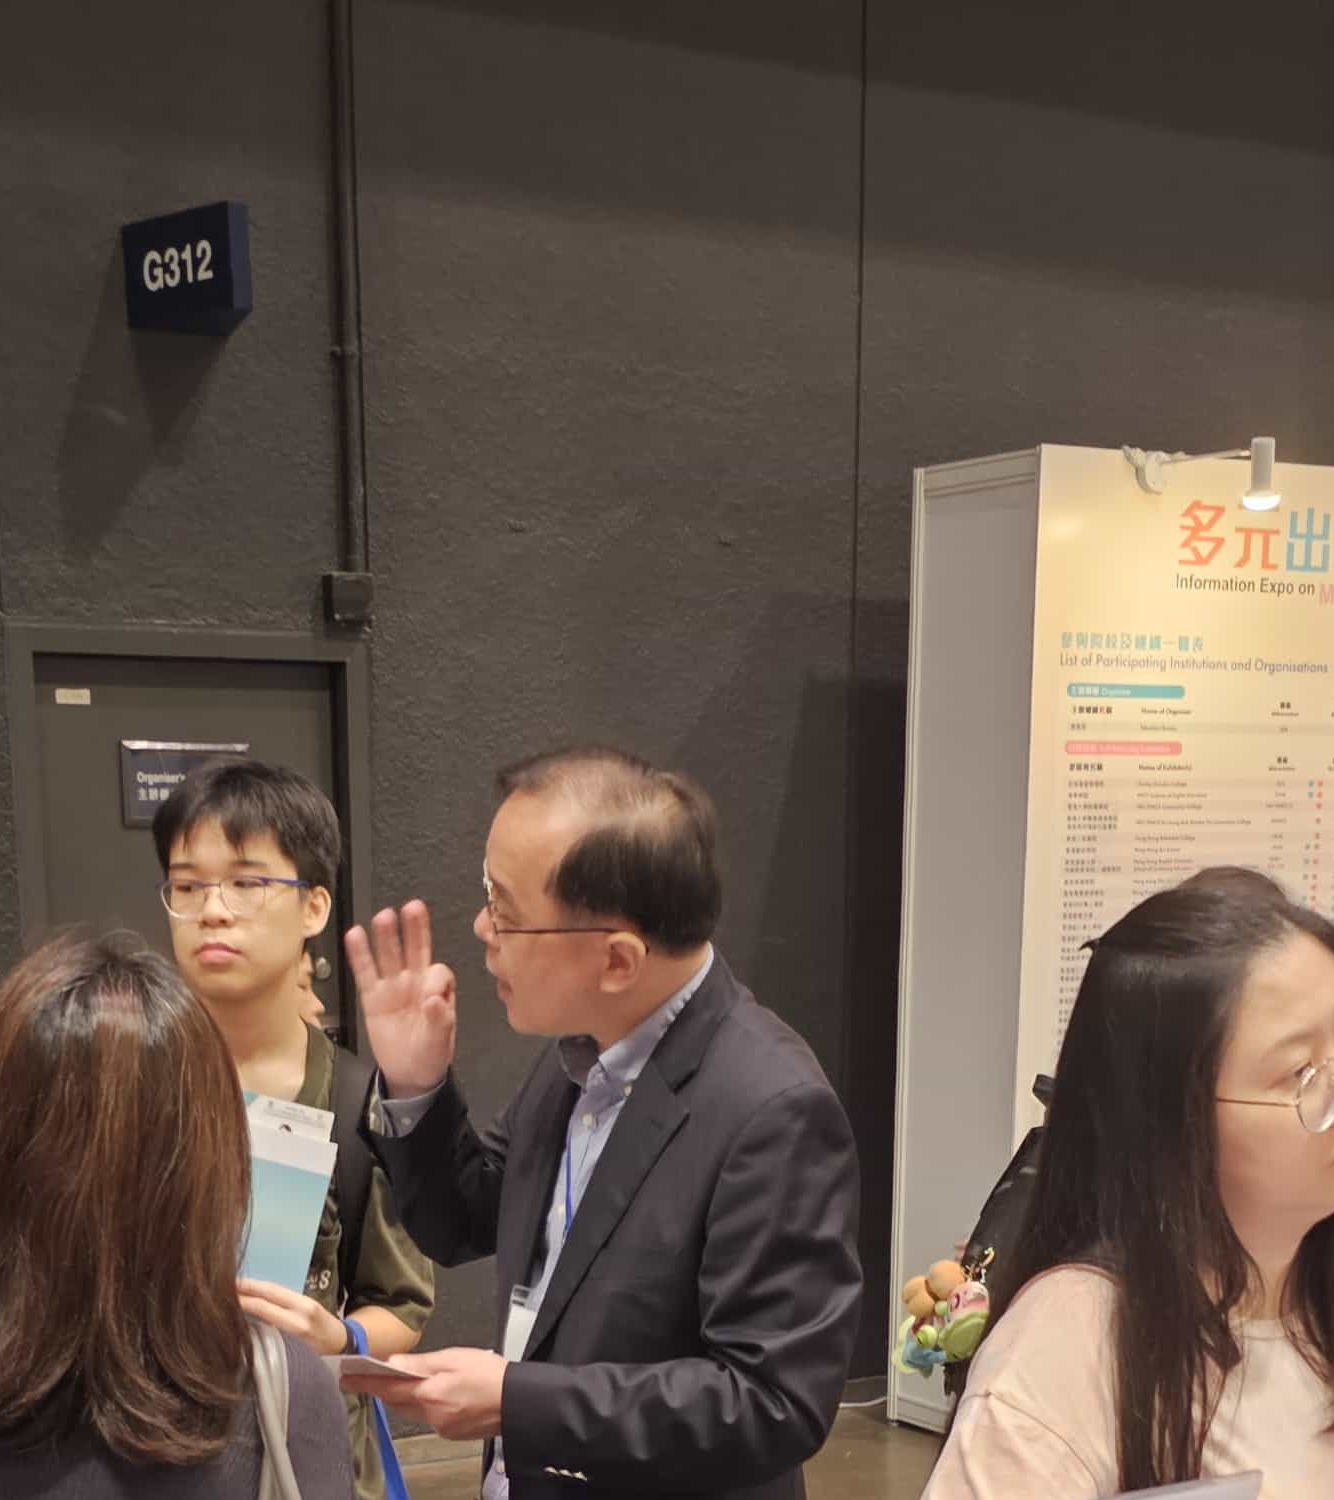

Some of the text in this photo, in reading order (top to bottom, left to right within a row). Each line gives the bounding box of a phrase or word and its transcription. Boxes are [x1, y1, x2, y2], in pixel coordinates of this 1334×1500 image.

[143, 239, 214, 292] G312
[1175, 573, 1255, 594] Information
[1260, 578, 1295, 598] Expo
[1298, 583, 1315, 597] on
[1059, 654, 1330, 676] List of Participating Institutions and Organisations
